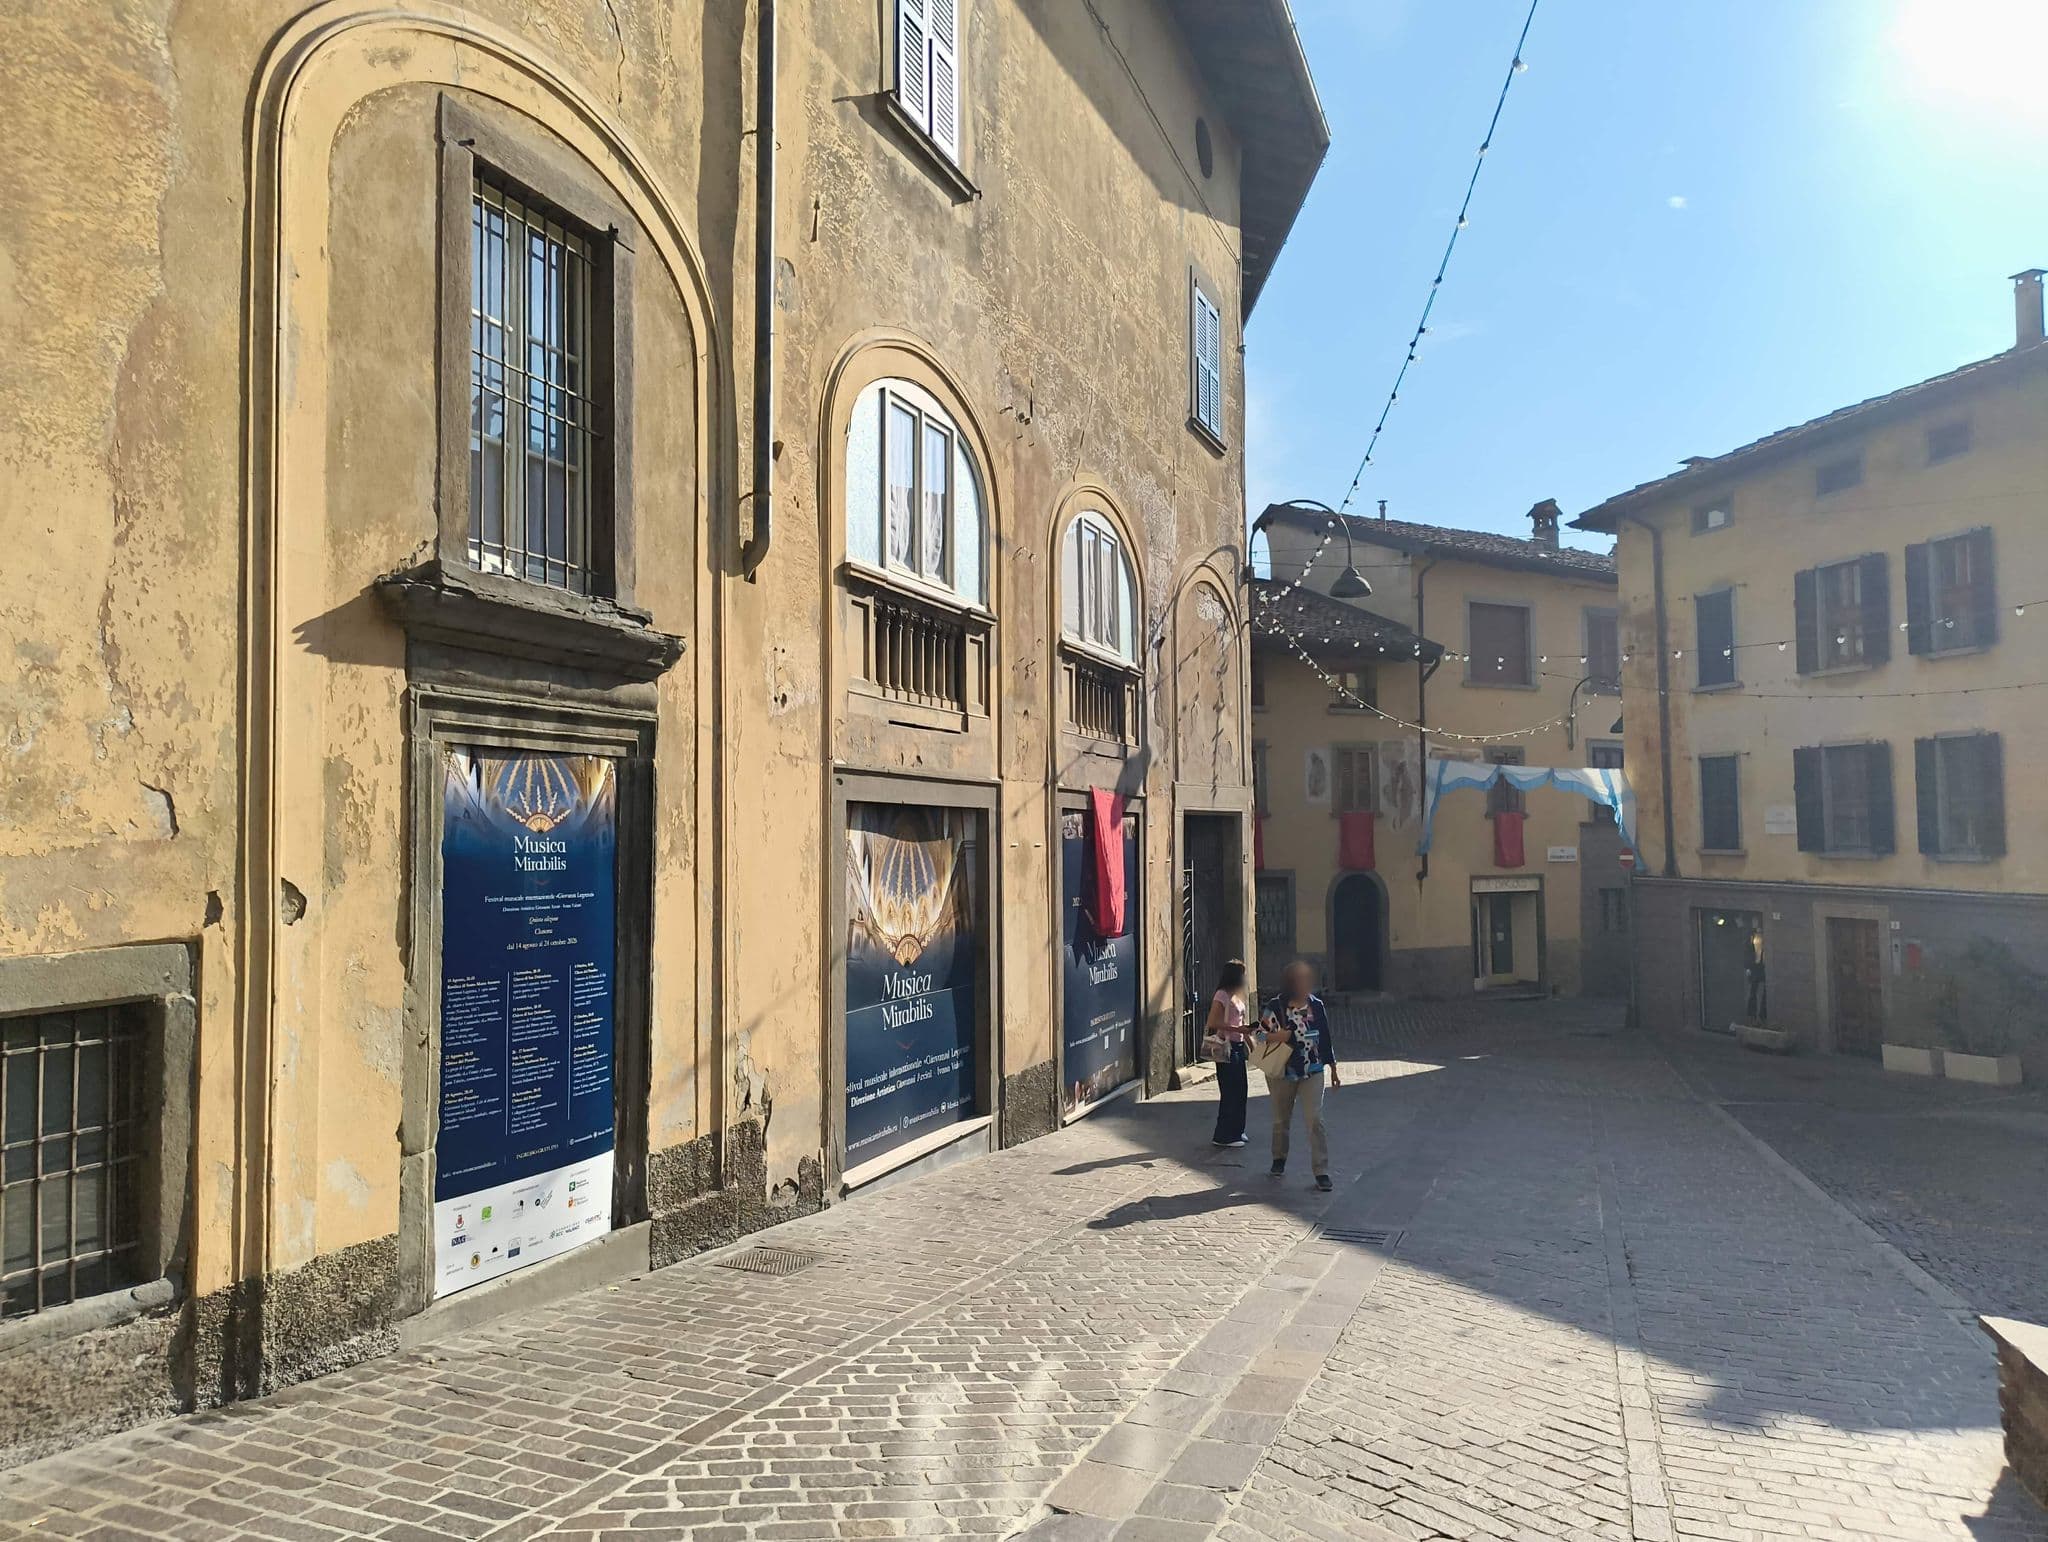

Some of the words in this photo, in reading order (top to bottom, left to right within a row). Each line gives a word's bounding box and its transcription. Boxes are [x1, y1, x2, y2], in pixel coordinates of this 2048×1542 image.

[513, 835, 567, 854] Musica
[513, 856, 567, 872] Mirabilis
[484, 895, 503, 903] Festival
[1088, 962, 1119, 987] Mirabilis
[880, 970, 932, 1002] Musica
[881, 998, 934, 1031] Mirabilis
[846, 1078, 863, 1094] stival
[864, 1070, 889, 1088] musicale
[888, 1058, 923, 1079] internazionale
[850, 1090, 876, 1108] Direzione
